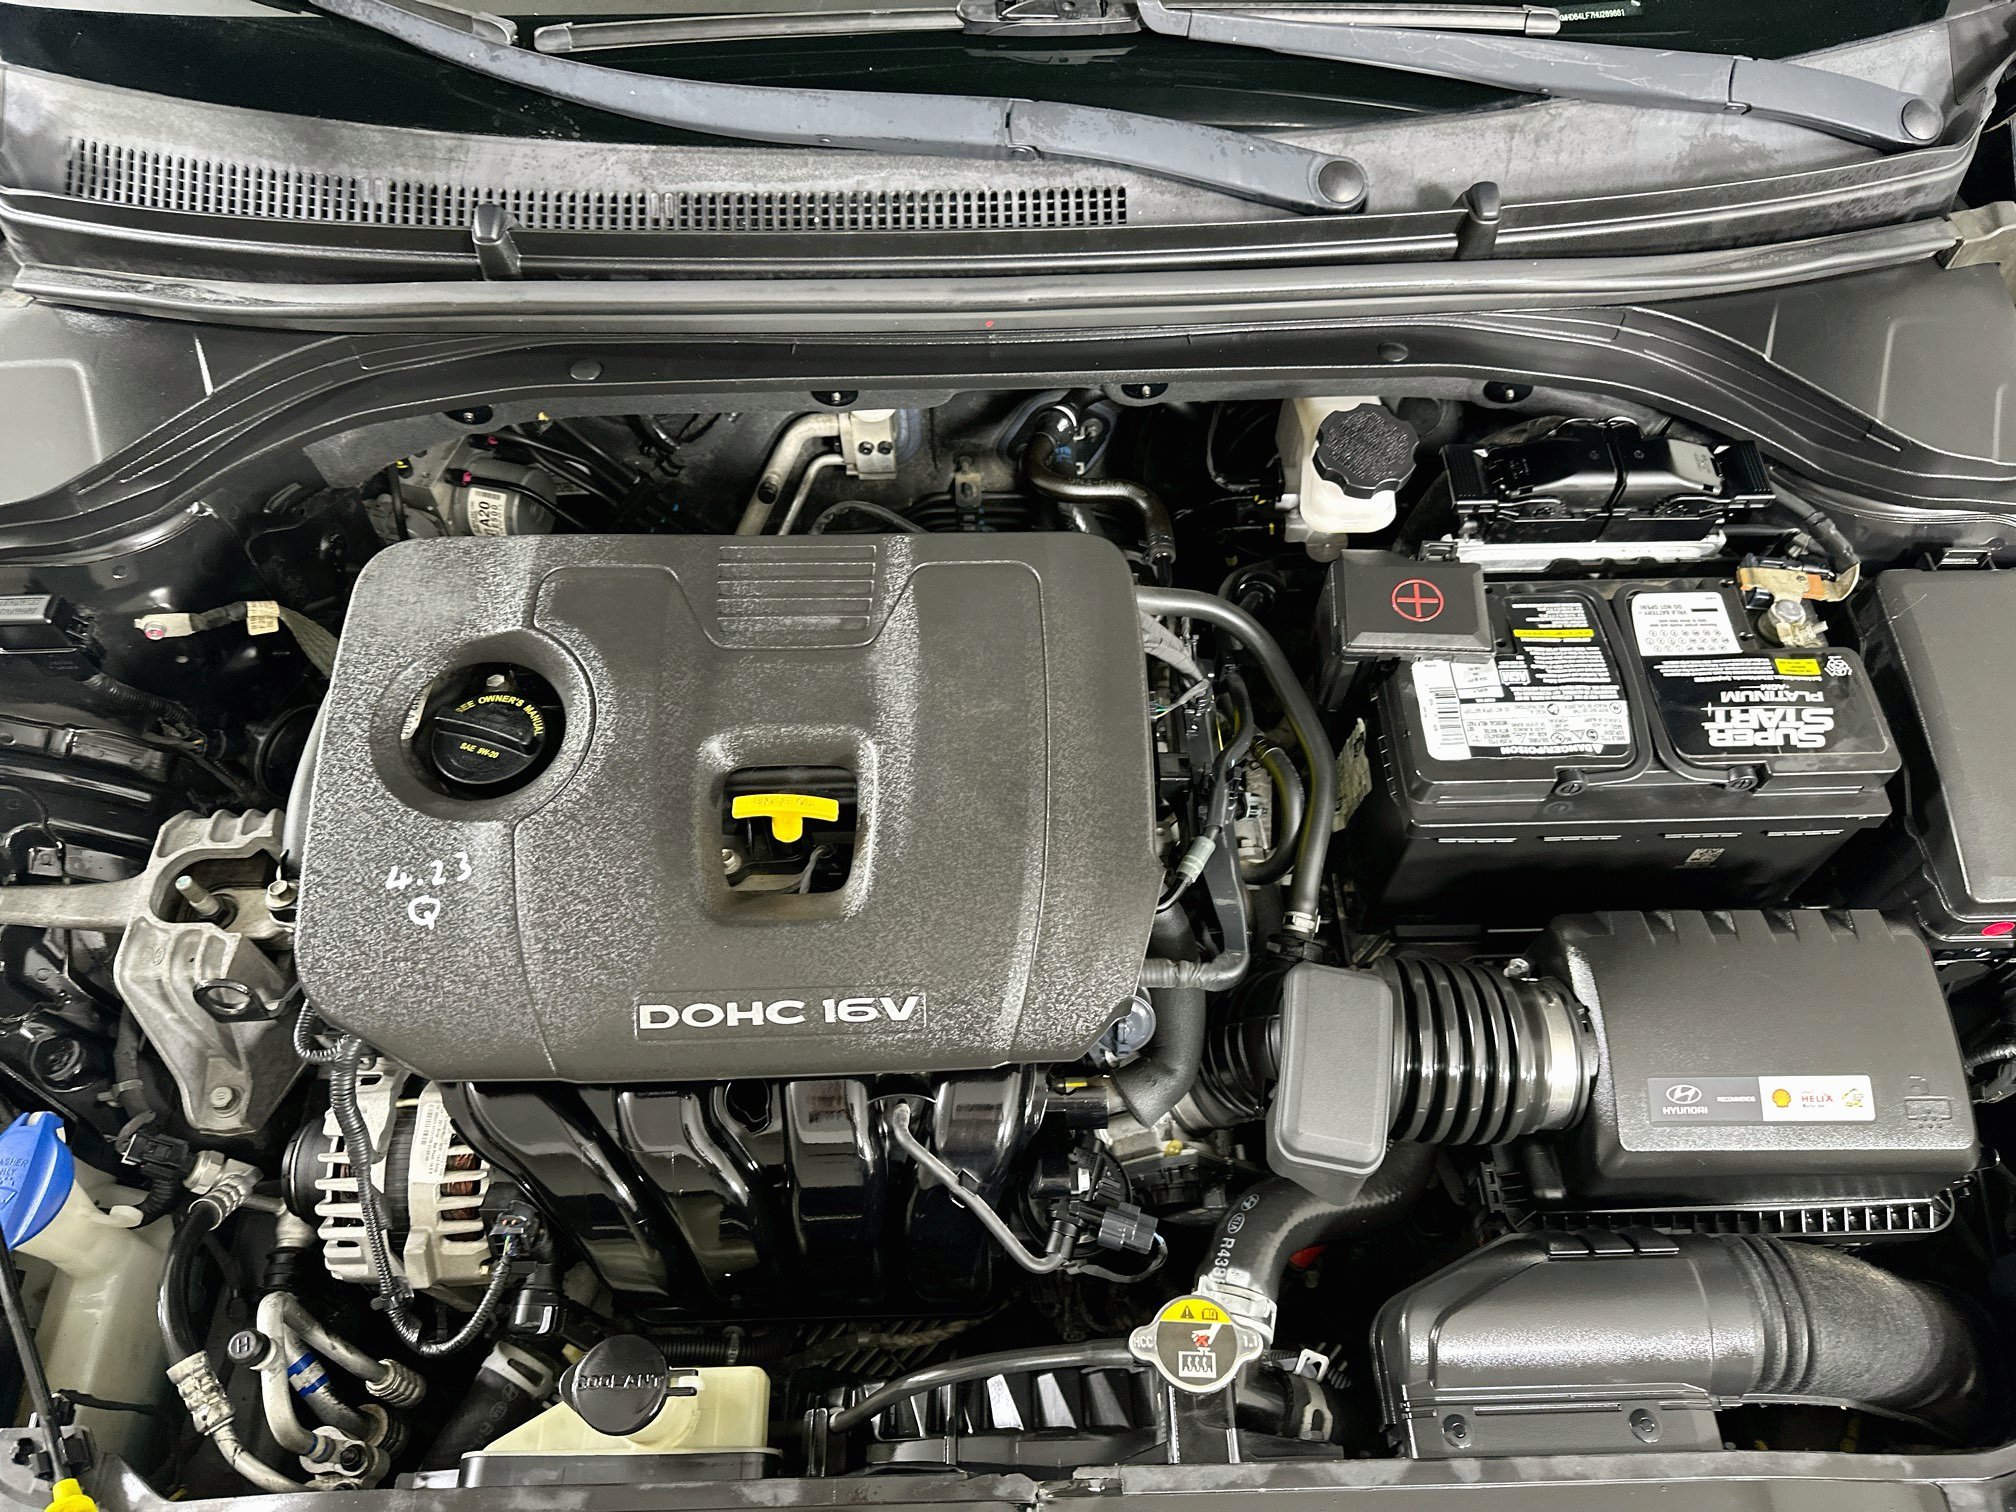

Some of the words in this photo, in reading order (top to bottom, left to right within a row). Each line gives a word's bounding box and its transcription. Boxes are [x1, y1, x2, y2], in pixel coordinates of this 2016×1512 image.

[1720, 690, 1825, 703] PLATINUM
[478, 695, 525, 707] OWNER'S
[523, 704, 544, 737] MANUAL
[1703, 708, 1835, 732] START
[1708, 728, 1826, 748] SUPER
[459, 742, 477, 752] SAE
[1500, 744, 1593, 754] DANGER/POISON
[639, 1000, 807, 1030] DOHC
[822, 995, 919, 1023] 16V
[1801, 1093, 1834, 1102] HELIX
[1662, 1106, 1708, 1115] HYUNDAI
[0, 1158, 29, 1168] ASHER
[1228, 1214, 1244, 1233] KIA
[236, 1336, 250, 1353] H
[1133, 1336, 1154, 1348] HCC
[1243, 1335, 1259, 1347] 1.1
